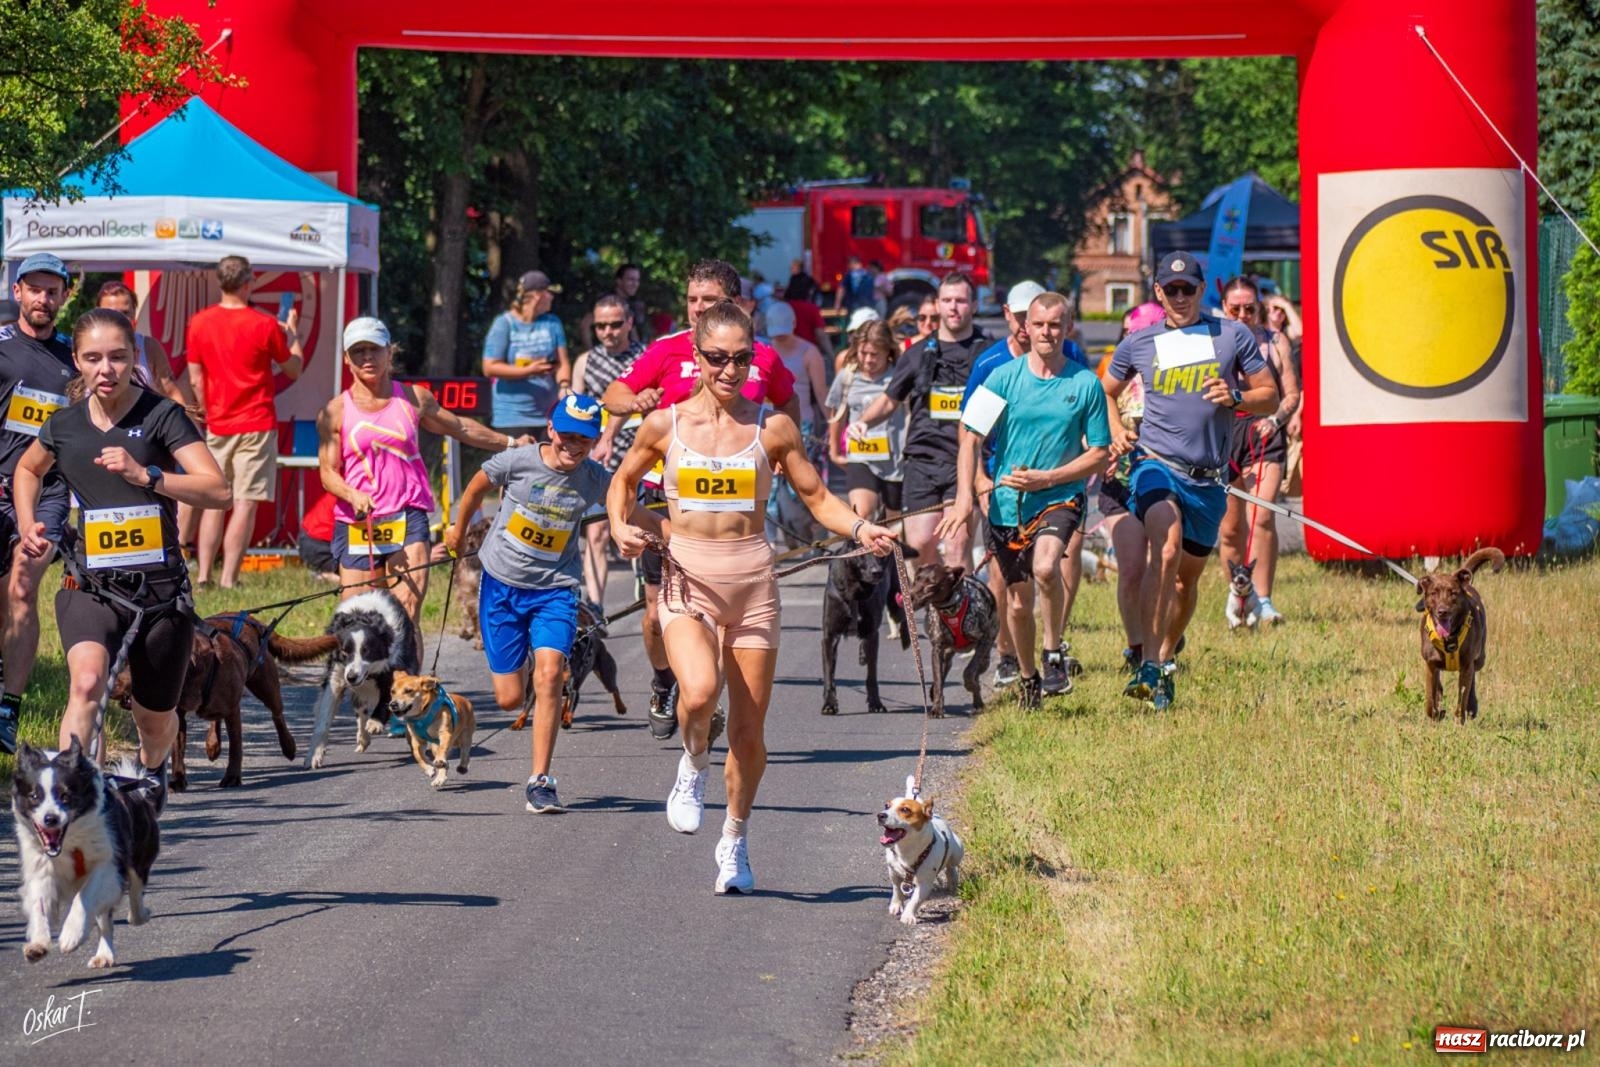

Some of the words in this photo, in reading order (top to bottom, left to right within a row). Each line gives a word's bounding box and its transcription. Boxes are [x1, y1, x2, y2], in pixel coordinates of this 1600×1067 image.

[27, 219, 147, 238] PersonalBest
[940, 400, 961, 409] 00
[23, 406, 52, 422] 01
[696, 478, 737, 494] 021
[99, 528, 144, 549] 026
[362, 529, 393, 541] 029
[521, 527, 555, 548] 031
